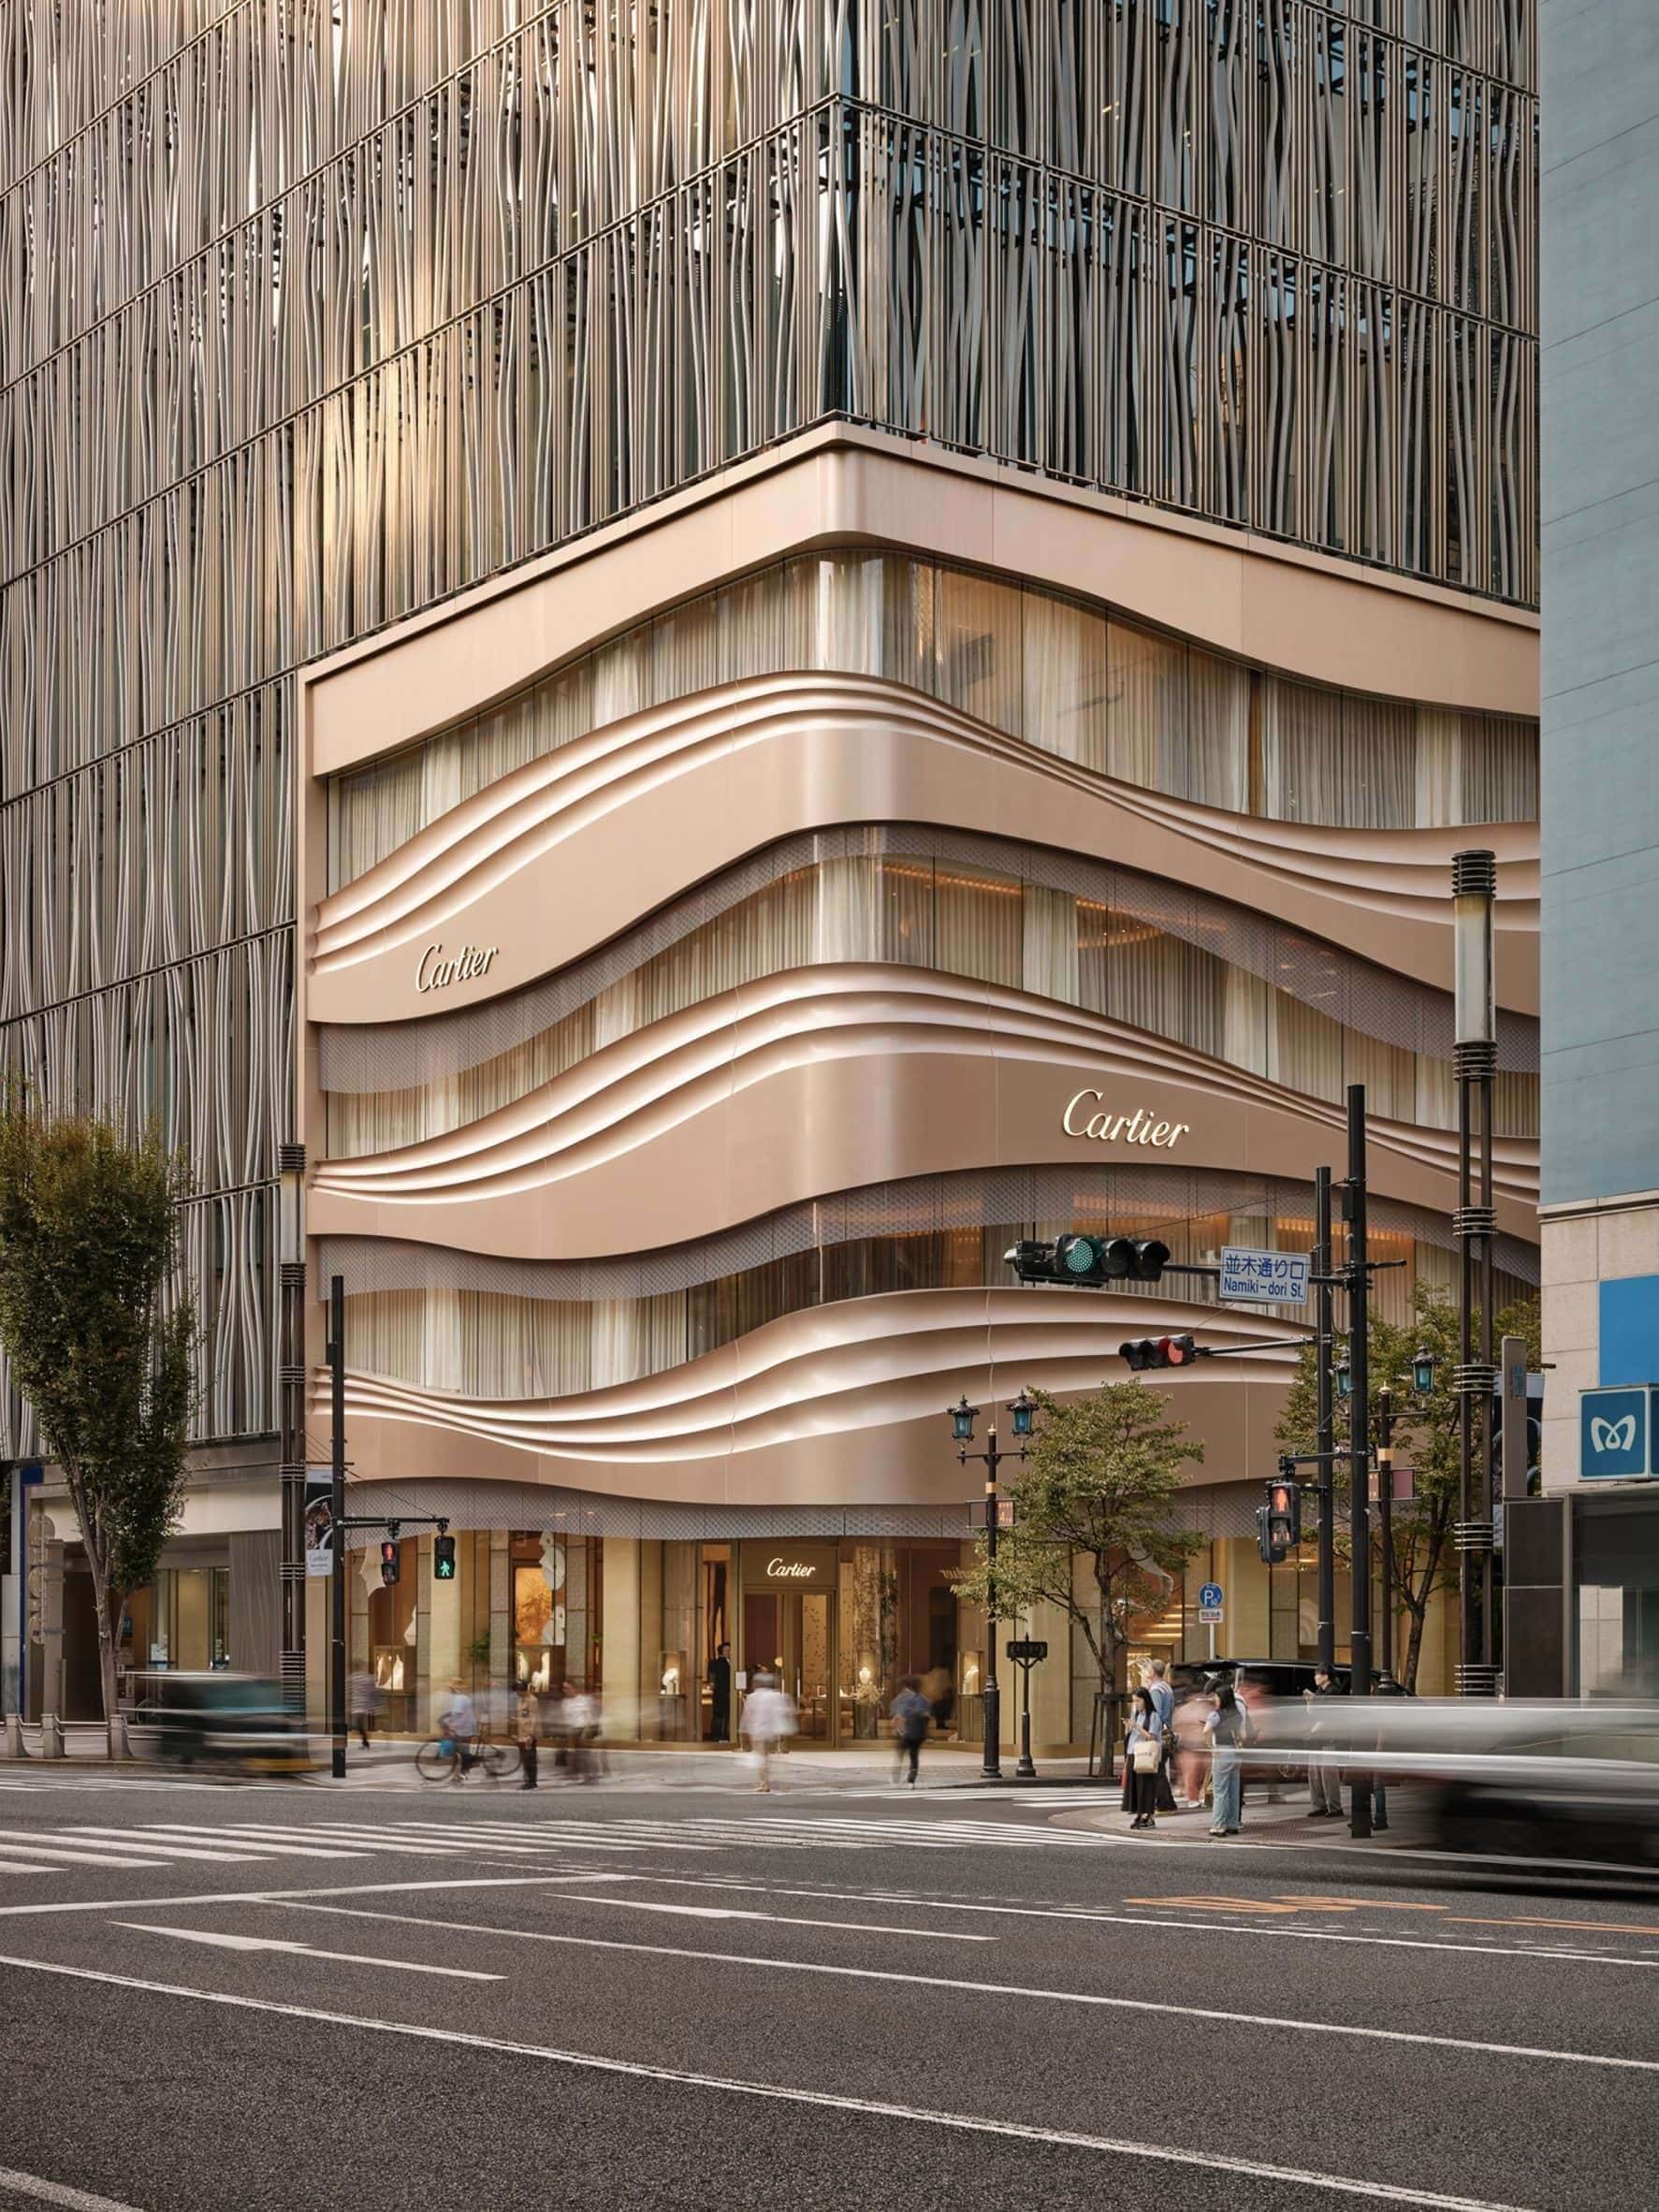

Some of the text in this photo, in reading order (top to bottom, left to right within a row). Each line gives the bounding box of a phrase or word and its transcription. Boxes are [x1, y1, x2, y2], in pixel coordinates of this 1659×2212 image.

[415, 943, 500, 993] Cartier
[1063, 1088, 1190, 1148] Cartier
[1225, 1254, 1304, 1279] 並木通り口
[1290, 1282, 1303, 1299] St.
[766, 1557, 816, 1577] Cartier
[1203, 1589, 1215, 1607] P
